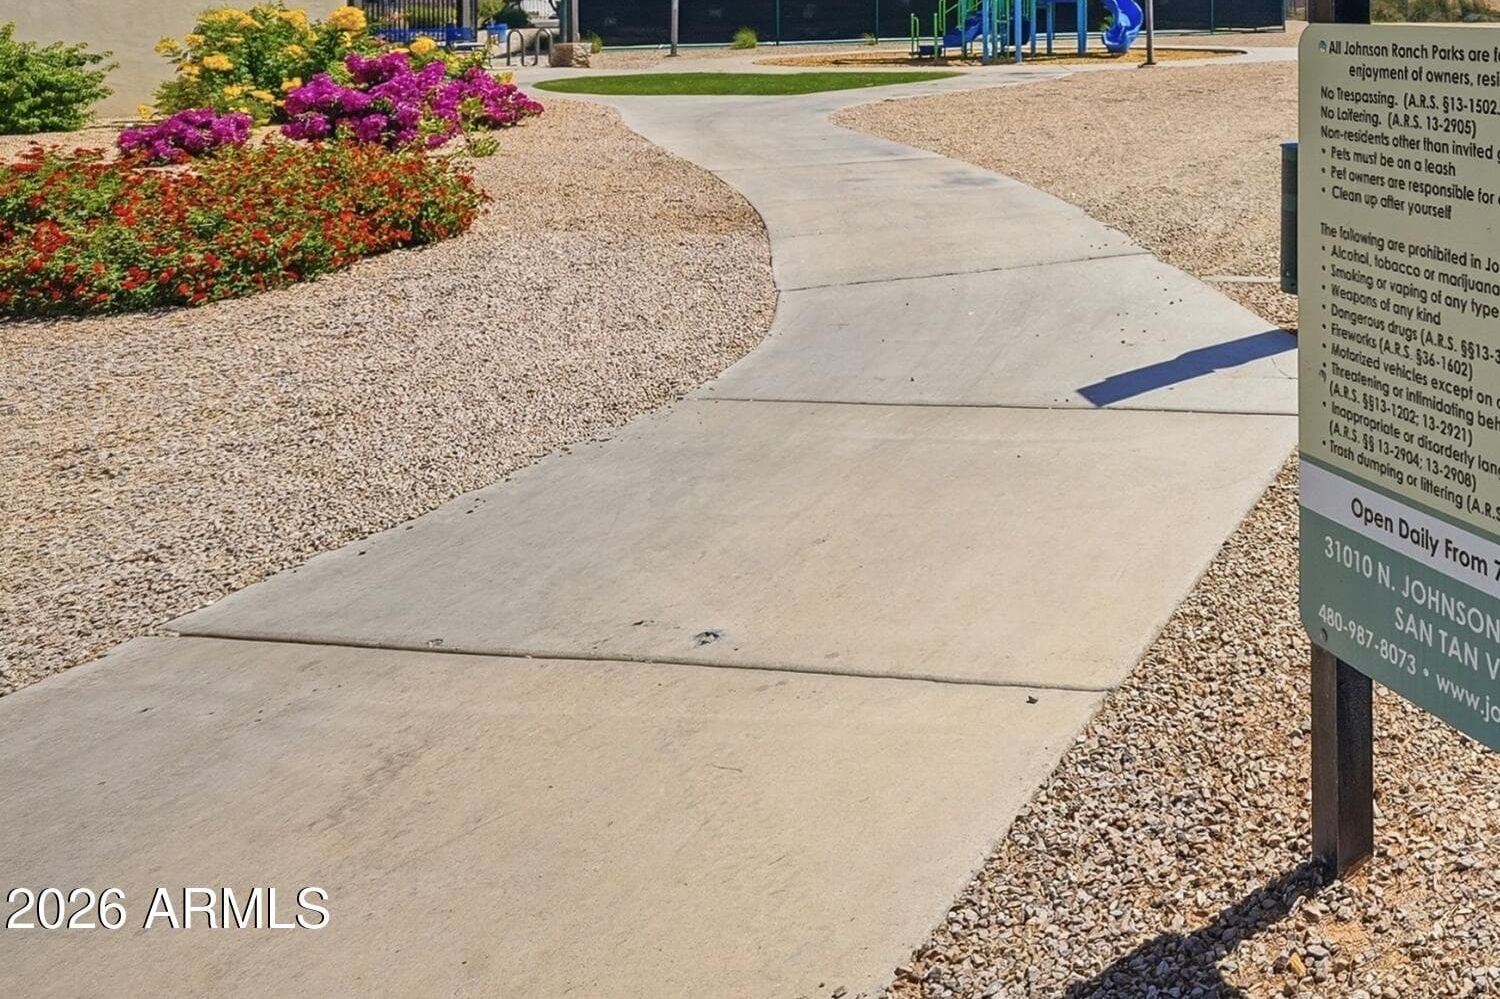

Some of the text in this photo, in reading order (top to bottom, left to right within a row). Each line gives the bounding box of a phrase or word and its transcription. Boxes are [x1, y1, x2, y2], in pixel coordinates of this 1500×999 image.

[1328, 39, 1342, 55] All
[1343, 39, 1389, 58] Johnson
[1391, 41, 1429, 60] Ranch
[1431, 43, 1465, 62] Parks
[1468, 48, 1490, 63] are
[1320, 84, 1335, 101] No
[1336, 85, 1399, 110] Trespassing.
[1348, 62, 1409, 83] enjoyment
[1411, 65, 1423, 82] of
[1425, 69, 1474, 88] owners,
[1320, 104, 1336, 120] No
[1337, 106, 1382, 128] Loitering.
[1426, 114, 1477, 140] 13-2905)
[1320, 124, 1390, 147] Non-residents
[1391, 133, 1421, 151] other
[1422, 136, 1450, 155] than
[1452, 139, 1494, 161] invited
[1331, 144, 1456, 177] Pets must be on a leash
[1330, 164, 1347, 181] Pet
[1348, 170, 1386, 188] owners
[1387, 176, 1406, 191] are
[1408, 179, 1475, 202] responsible
[1477, 186, 1495, 205] for
[1331, 184, 1452, 221] Clean up after yourself
[1320, 220, 1338, 239] The
[1339, 224, 1385, 253] following
[1387, 238, 1406, 254] are
[1408, 243, 1468, 267] prohibited
[1470, 252, 1482, 271] in
[1330, 243, 1373, 268] Alcohol,
[1373, 253, 1421, 278] tobacco
[1423, 267, 1436, 282] or
[1438, 270, 1500, 297] marijuana
[1330, 262, 1374, 291] Smoking
[1376, 277, 1388, 291] or
[1389, 280, 1428, 305] vaping
[1430, 288, 1443, 305] of
[1444, 294, 1468, 315] any
[1470, 297, 1500, 320] type
[1330, 282, 1442, 326] Weapons of any kind
[1330, 302, 1386, 332] Dangerous
[1387, 319, 1418, 343] drugs
[1331, 321, 1378, 350] Fireworks
[1330, 341, 1381, 371] Motorized
[1383, 361, 1428, 387] vehicles
[1430, 376, 1474, 402] except
[1476, 390, 1493, 408] on
[1331, 360, 1390, 398] Threatening
[1392, 385, 1404, 399] or
[1405, 385, 1475, 427] intimidating
[1331, 399, 1401, 440] Inappropriate
[1403, 430, 1415, 445] or
[1417, 433, 1476, 470] disorderly
[1422, 412, 1473, 449] 13-2921)
[1329, 438, 1355, 462] Trash
[1356, 450, 1404, 486] dumping
[1406, 473, 1418, 488] or
[1420, 475, 1464, 510] littering
[1378, 437, 1423, 471] 13-2904;
[1426, 456, 1477, 494] 13-2908)
[1351, 497, 1393, 533] Open
[1398, 517, 1439, 557] Daily
[1444, 537, 1487, 576] From
[1324, 535, 1372, 578] 31010
[1378, 561, 1395, 591] N.
[1401, 575, 1500, 643] JOHNSON
[1318, 603, 1416, 675] 480-987-8073
[1394, 606, 1432, 647] SAN
[1438, 628, 1477, 671] TAN
